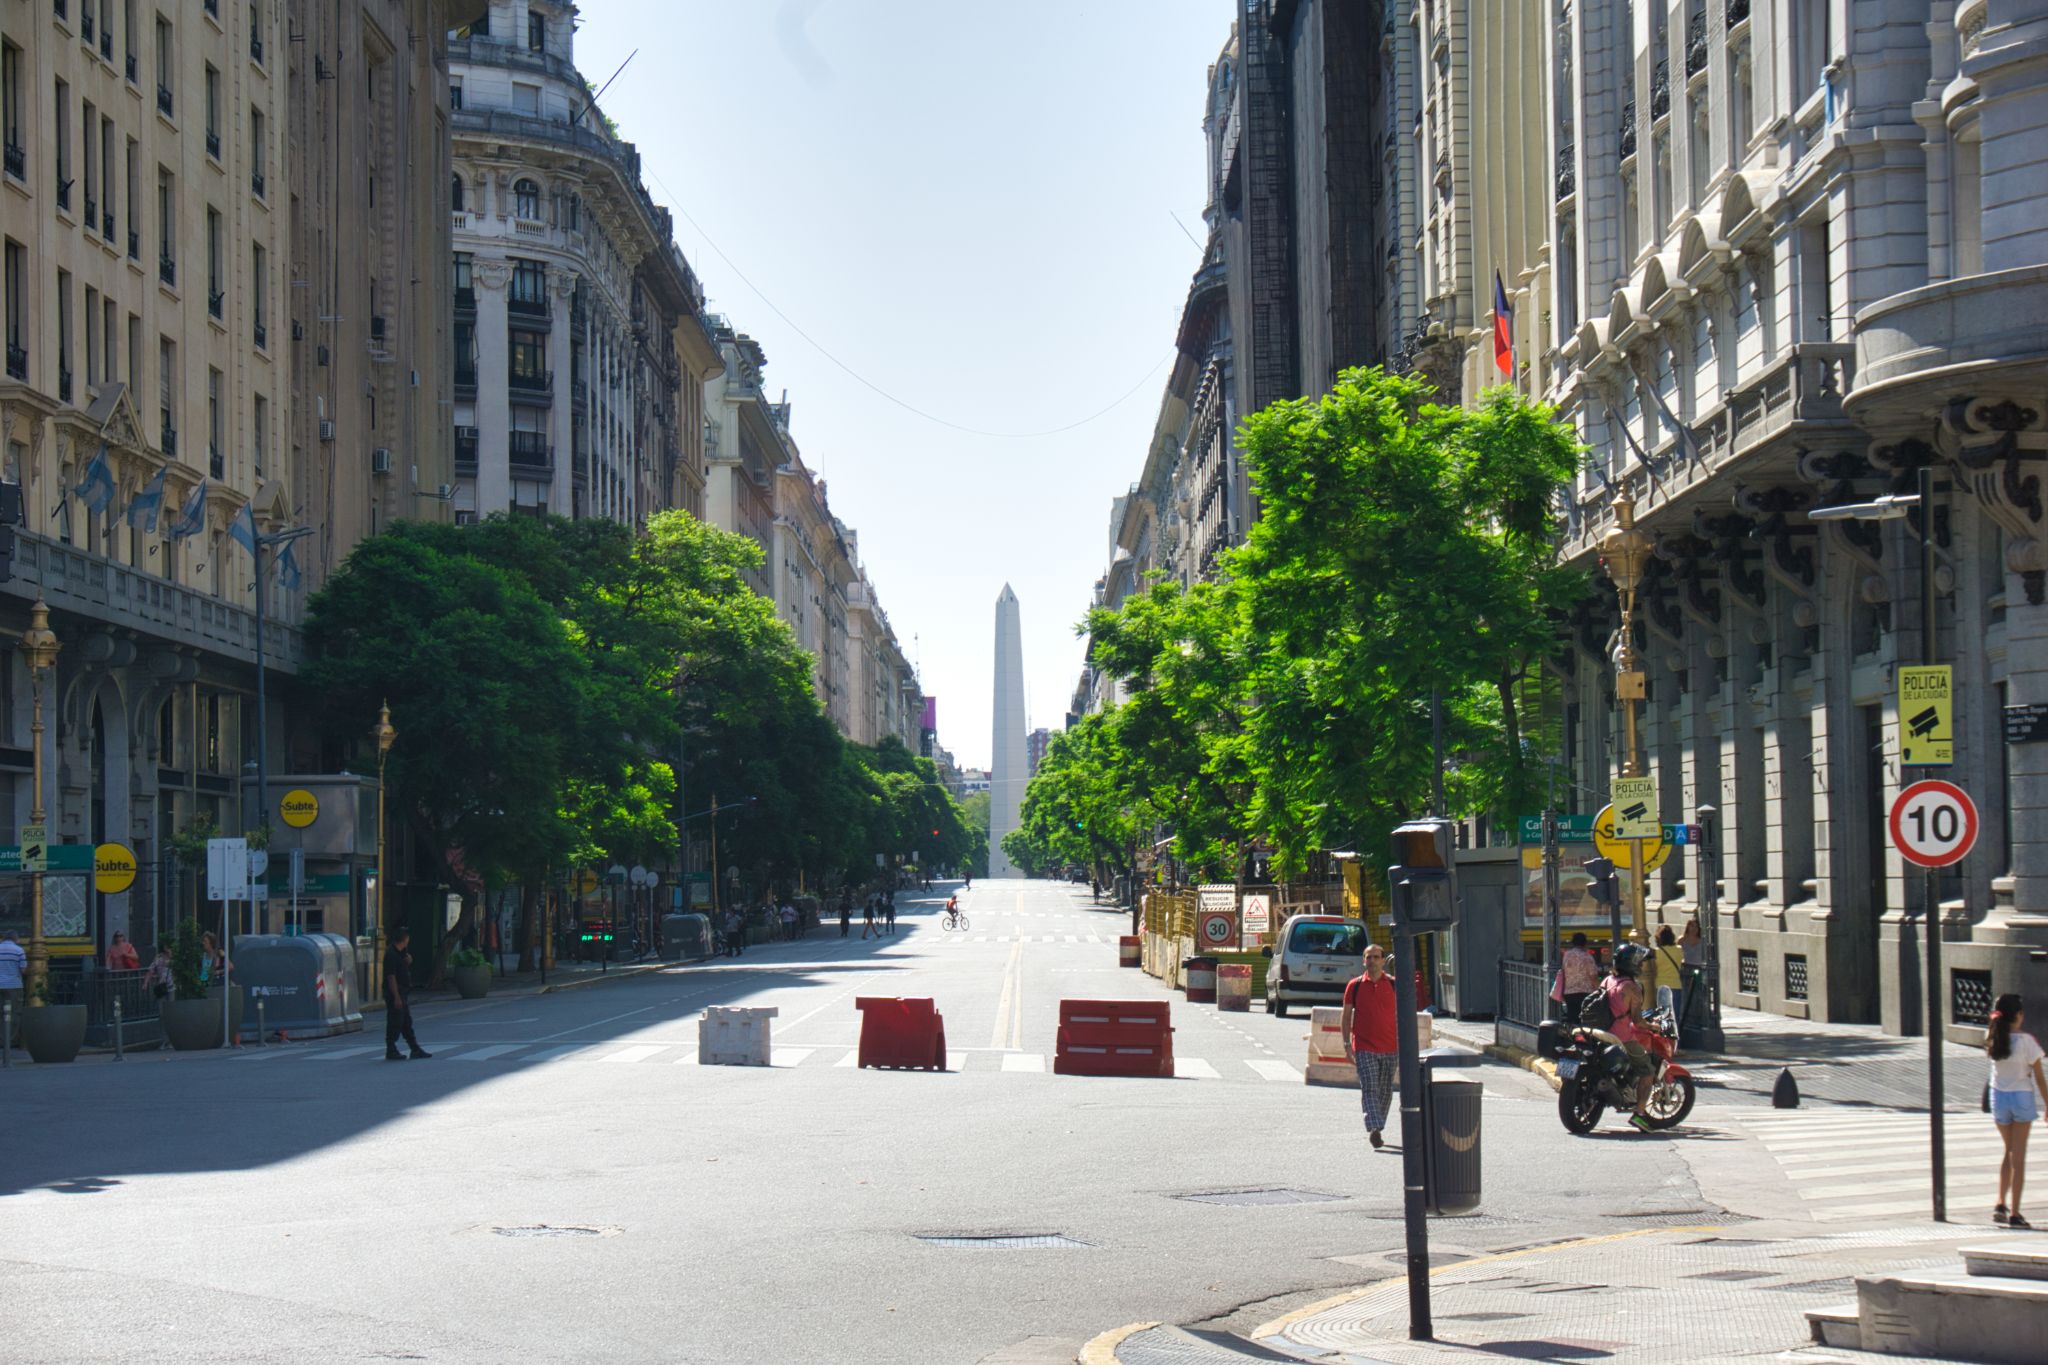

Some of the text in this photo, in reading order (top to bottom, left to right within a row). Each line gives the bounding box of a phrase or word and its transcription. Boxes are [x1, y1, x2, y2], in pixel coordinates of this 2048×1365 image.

[1904, 675, 1948, 690] POLICIA
[1904, 689, 1948, 700] DE LA CIUDAD
[1616, 783, 1652, 793] POLICIA
[285, 802, 314, 811] Subte
[1908, 804, 1958, 843] 10
[1664, 829, 1672, 840] D
[1676, 829, 1686, 840] A
[1690, 829, 1697, 840] E
[96, 859, 130, 871] Subte
[1209, 923, 1226, 936] 30
